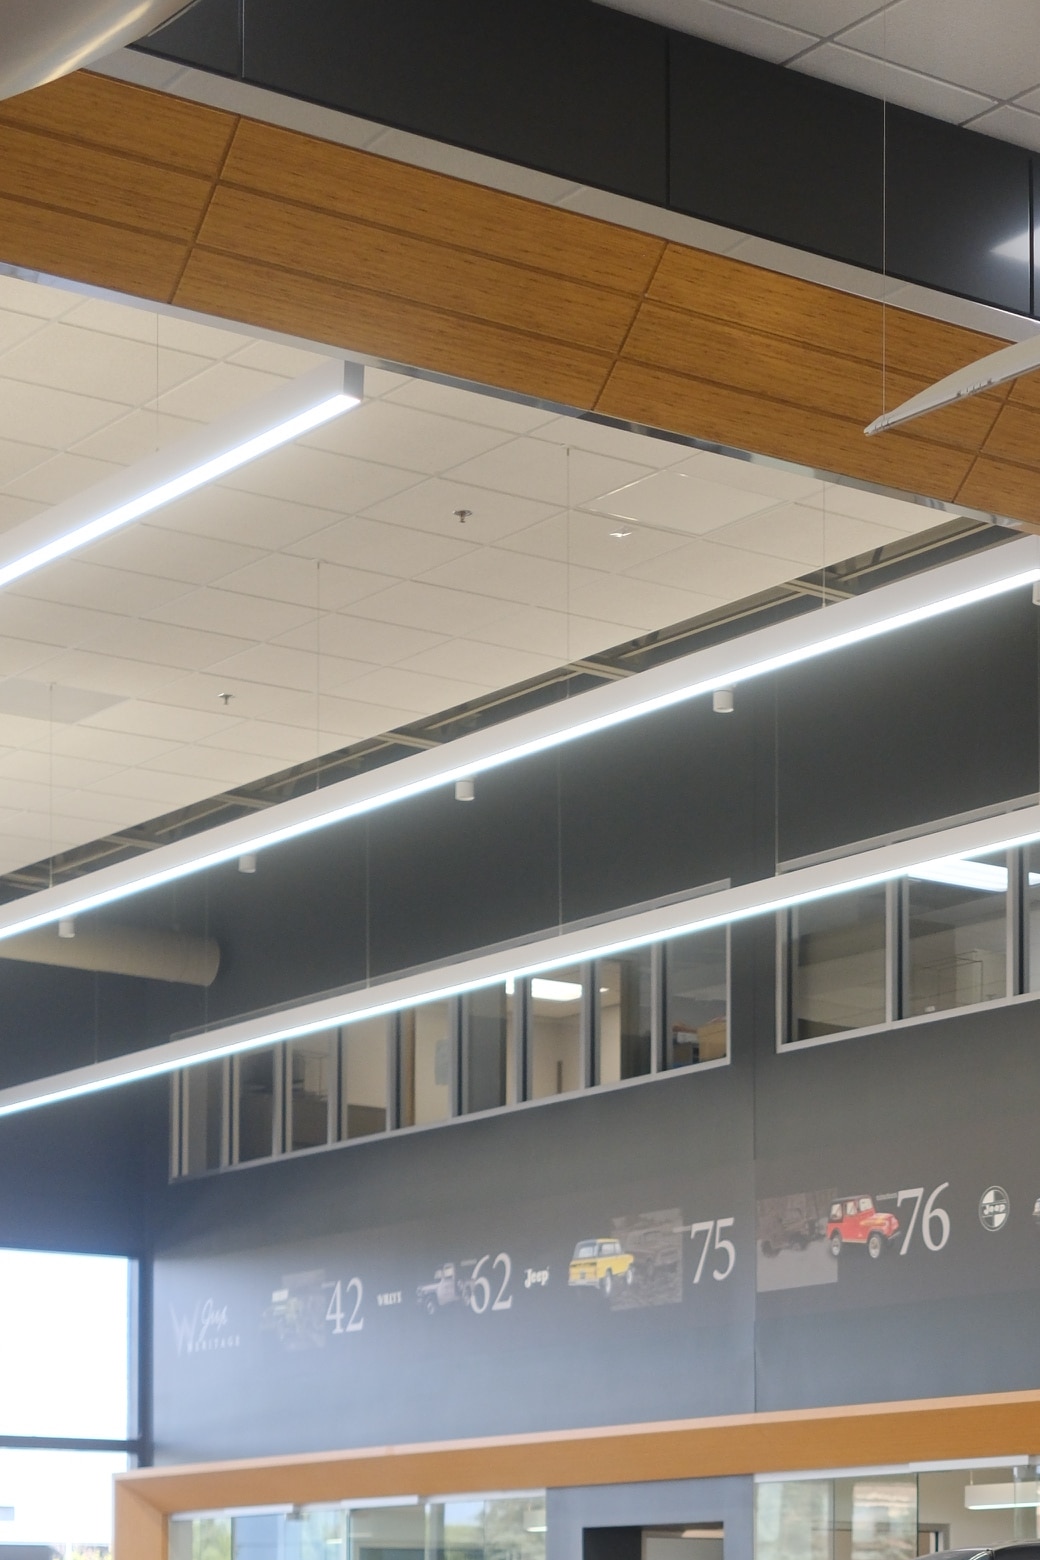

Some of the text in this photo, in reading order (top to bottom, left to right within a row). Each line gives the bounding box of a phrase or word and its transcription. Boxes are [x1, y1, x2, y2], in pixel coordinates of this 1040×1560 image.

[690, 1217, 736, 1284] 75
[897, 1182, 950, 1256] 76
[325, 1277, 364, 1334] 42
[470, 1252, 513, 1314] 62
